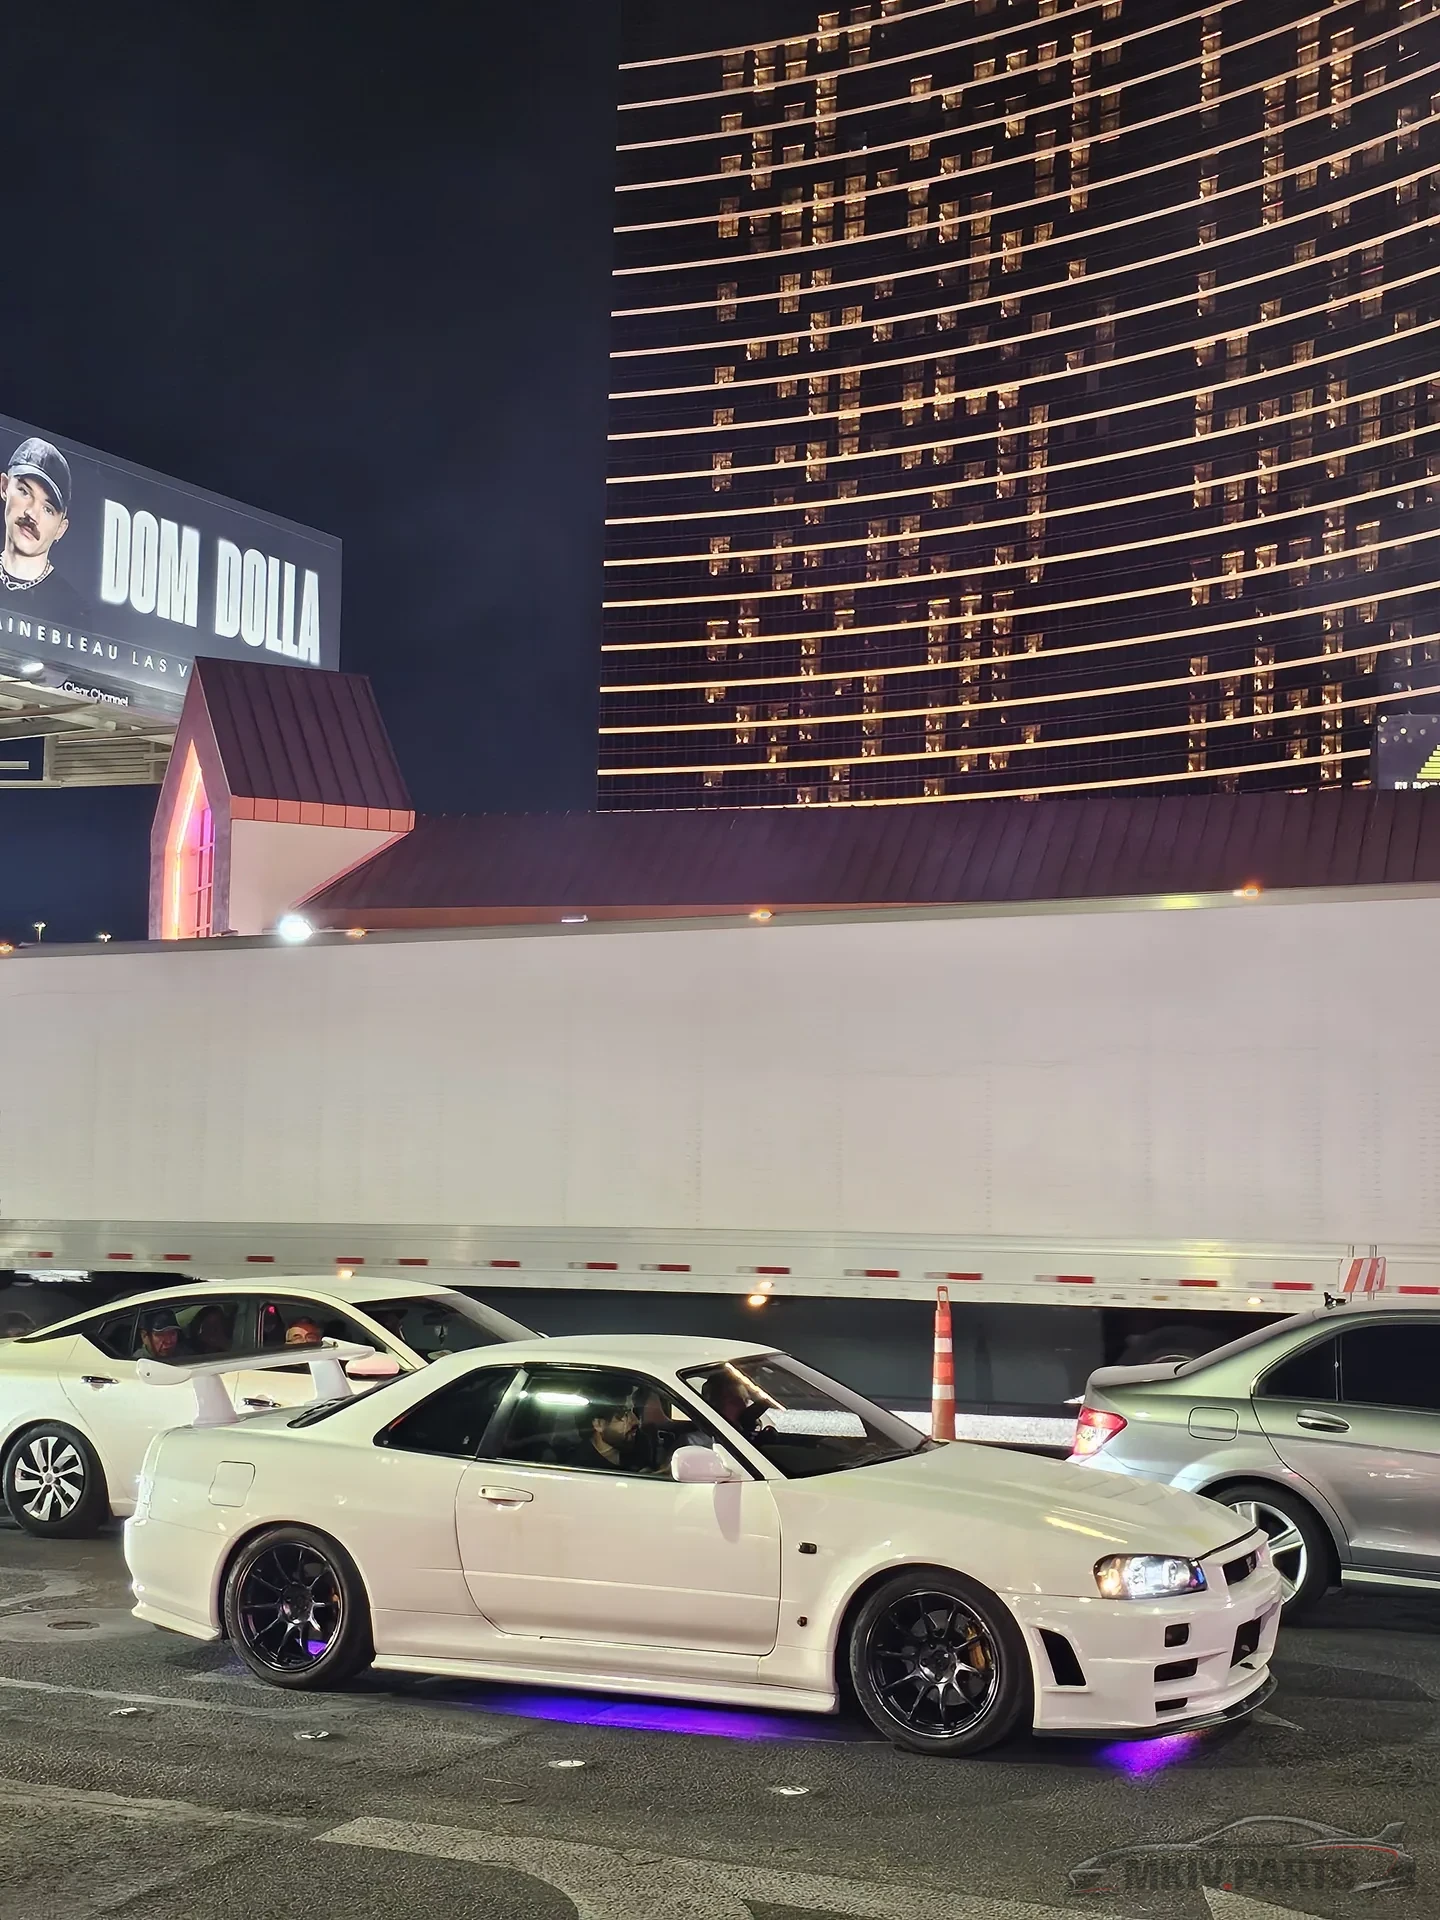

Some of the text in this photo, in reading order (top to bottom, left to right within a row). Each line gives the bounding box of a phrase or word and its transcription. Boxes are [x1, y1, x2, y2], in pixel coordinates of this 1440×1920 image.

[101, 499, 321, 666] DOM DOLLA
[132, 651, 167, 673] LAS
[64, 681, 129, 707] Clear Channel
